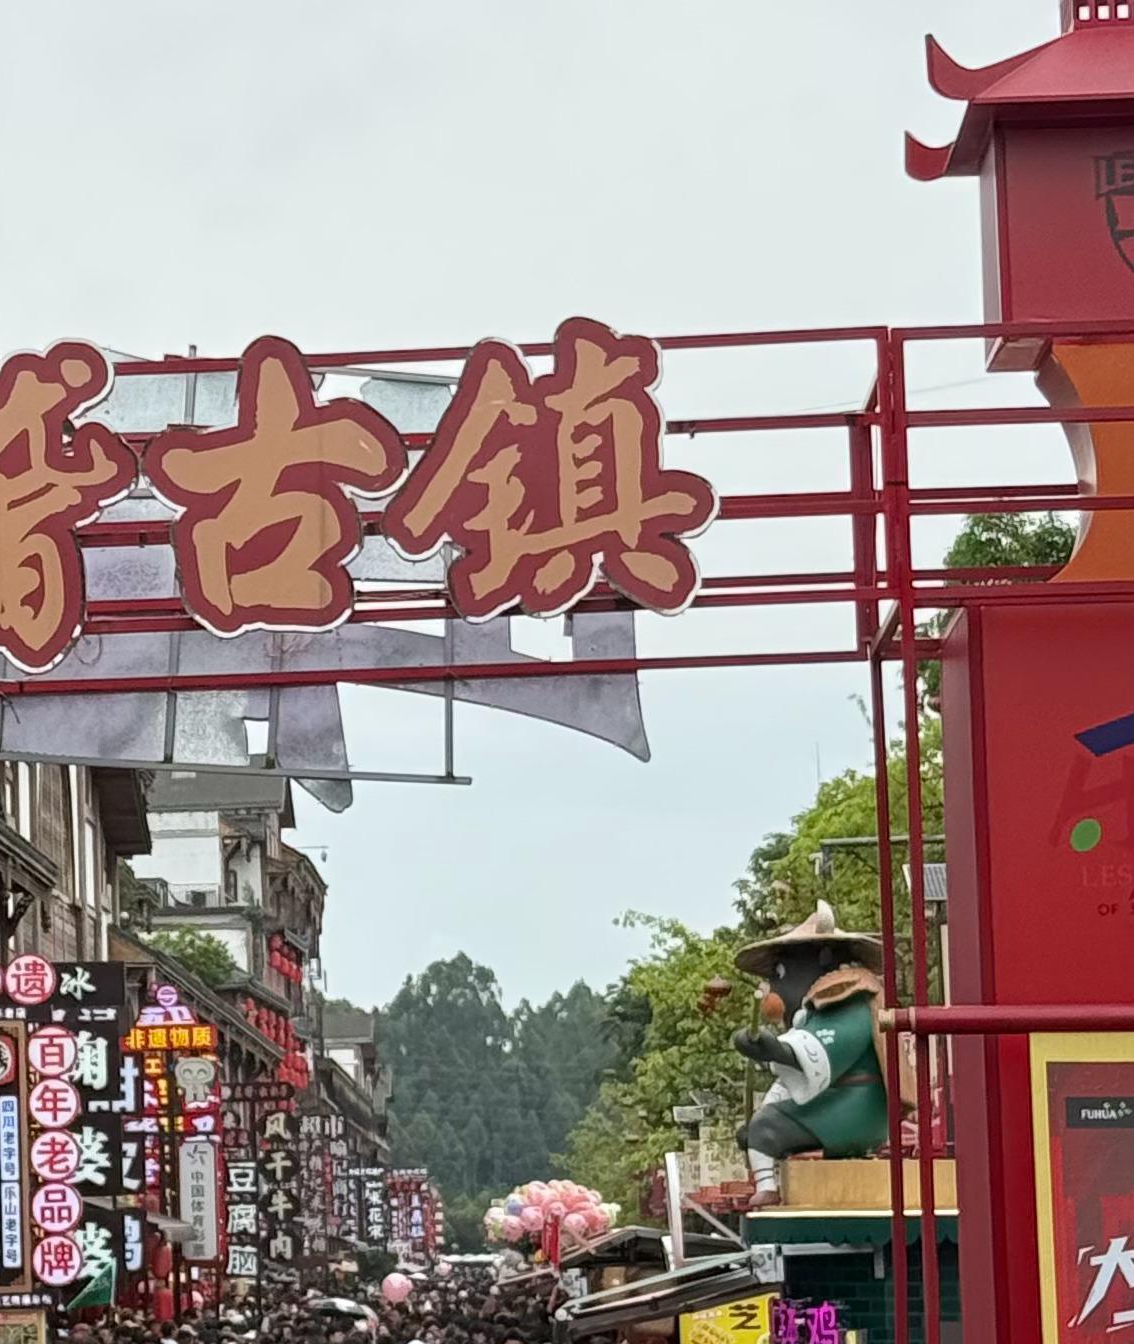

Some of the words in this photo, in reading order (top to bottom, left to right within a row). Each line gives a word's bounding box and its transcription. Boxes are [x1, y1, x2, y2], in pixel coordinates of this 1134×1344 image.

[1, 1099, 17, 1177] 四川老字号
[30, 1033, 76, 1277] 百年老品牌
[264, 1111, 293, 1260] 风干牛肉
[3, 1186, 19, 1264] 乐山老字号
[226, 1161, 259, 1276] 豆腐脑
